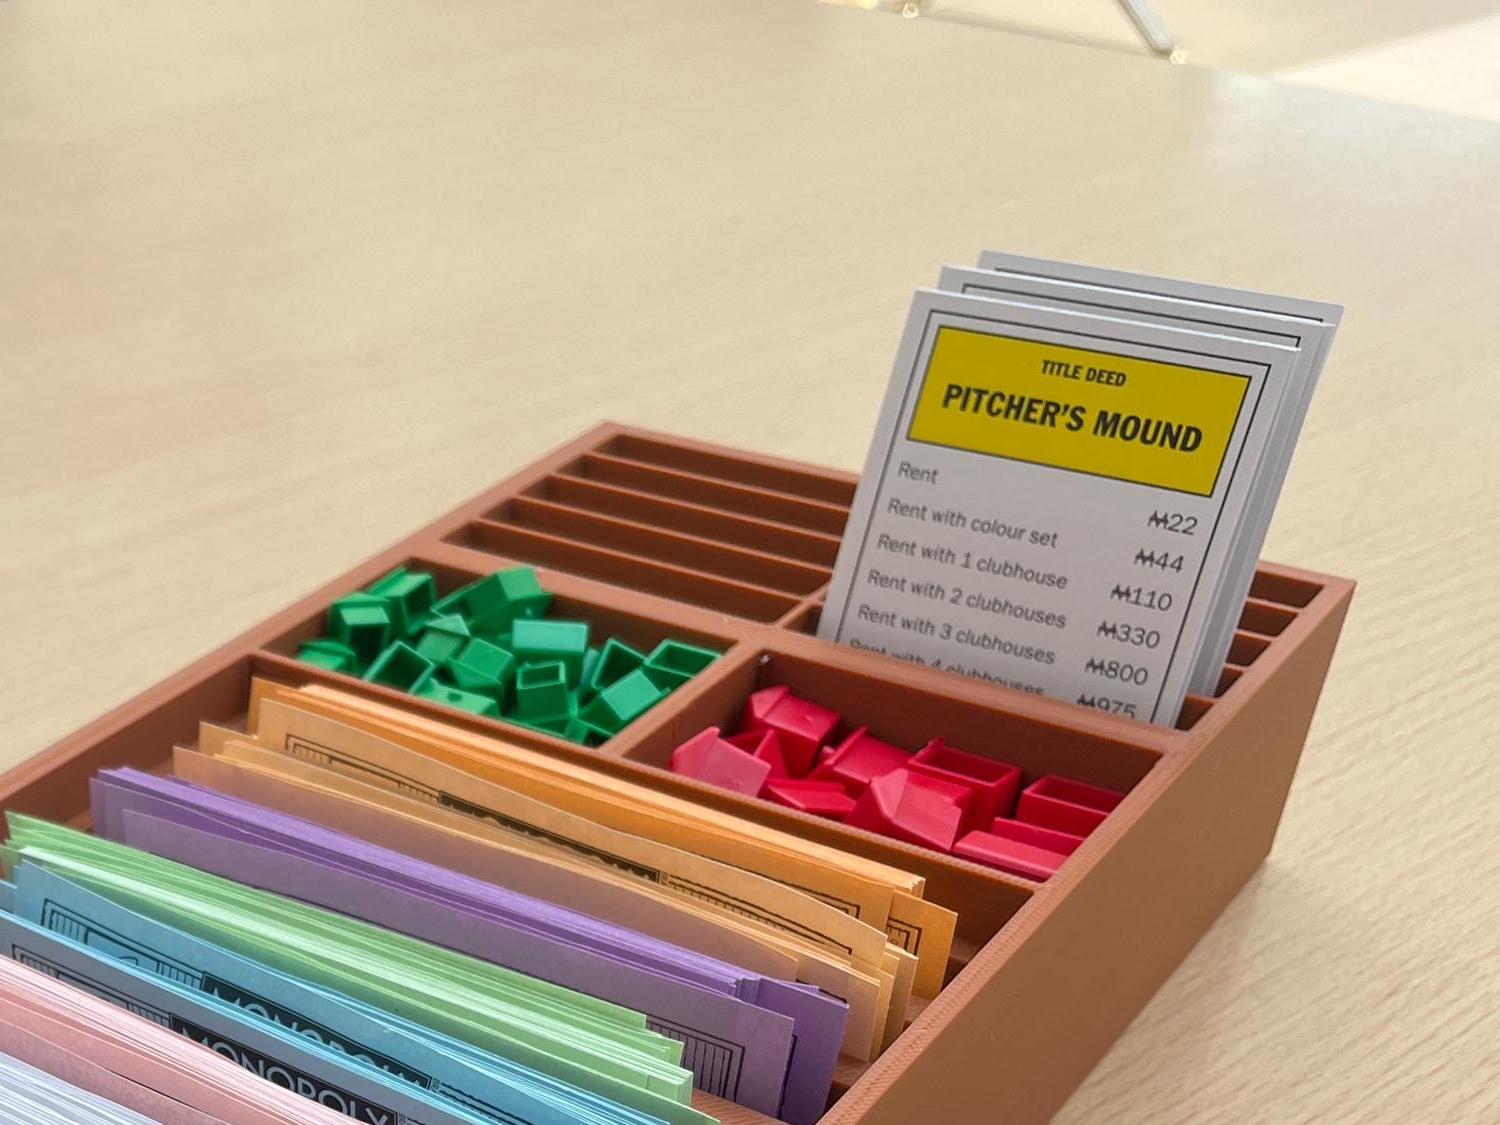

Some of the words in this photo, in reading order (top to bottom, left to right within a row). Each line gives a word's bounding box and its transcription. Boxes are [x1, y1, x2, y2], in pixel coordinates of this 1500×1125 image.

[1041, 359, 1082, 381] TITLE
[1085, 367, 1126, 388] DEED
[1092, 410, 1203, 453] MOUND
[898, 460, 939, 485] Rent
[887, 497, 928, 522] Rent
[931, 507, 967, 529] with
[970, 517, 1027, 541] colour
[1029, 530, 1059, 549] set
[877, 533, 918, 557] Rent
[921, 542, 956, 565] with
[961, 552, 972, 569] 1
[976, 556, 1068, 590] clubhouse
[867, 569, 907, 593] Rent
[910, 578, 945, 601] with
[949, 588, 963, 605] 2
[966, 592, 1067, 630] clubhouses
[857, 603, 897, 628] Rent
[900, 614, 935, 637] with
[939, 623, 952, 640] 3
[956, 628, 1056, 665] clubhouses
